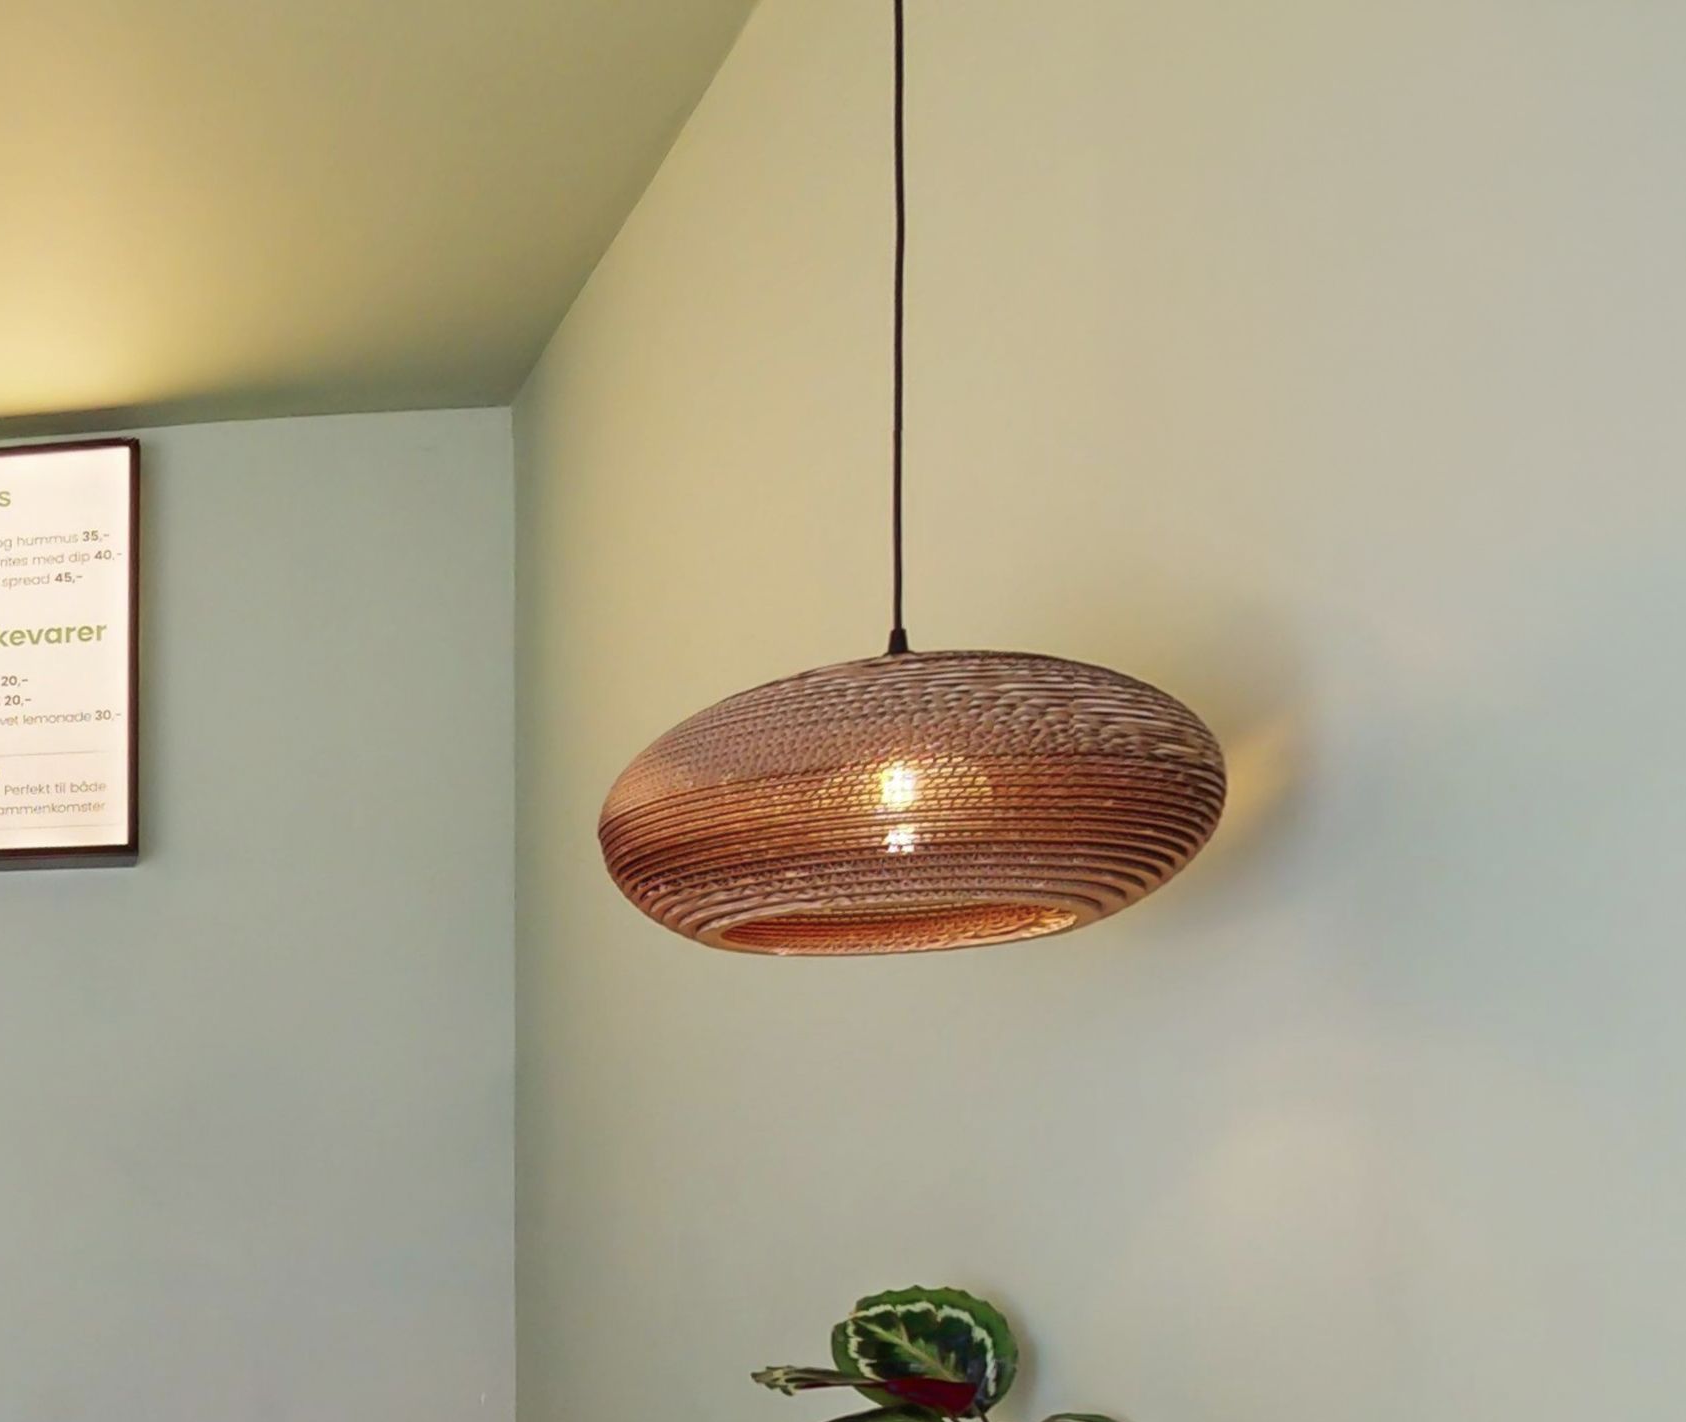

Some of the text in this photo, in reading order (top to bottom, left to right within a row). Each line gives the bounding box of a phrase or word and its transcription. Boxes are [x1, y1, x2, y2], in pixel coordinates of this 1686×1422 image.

[17, 533, 78, 546] hummus
[32, 552, 64, 565] med
[69, 551, 90, 564] dip
[2, 574, 50, 589] spread
[23, 711, 92, 726] lemonade
[4, 784, 50, 796] Perfekt
[55, 782, 66, 794] til
[70, 781, 107, 794] både
